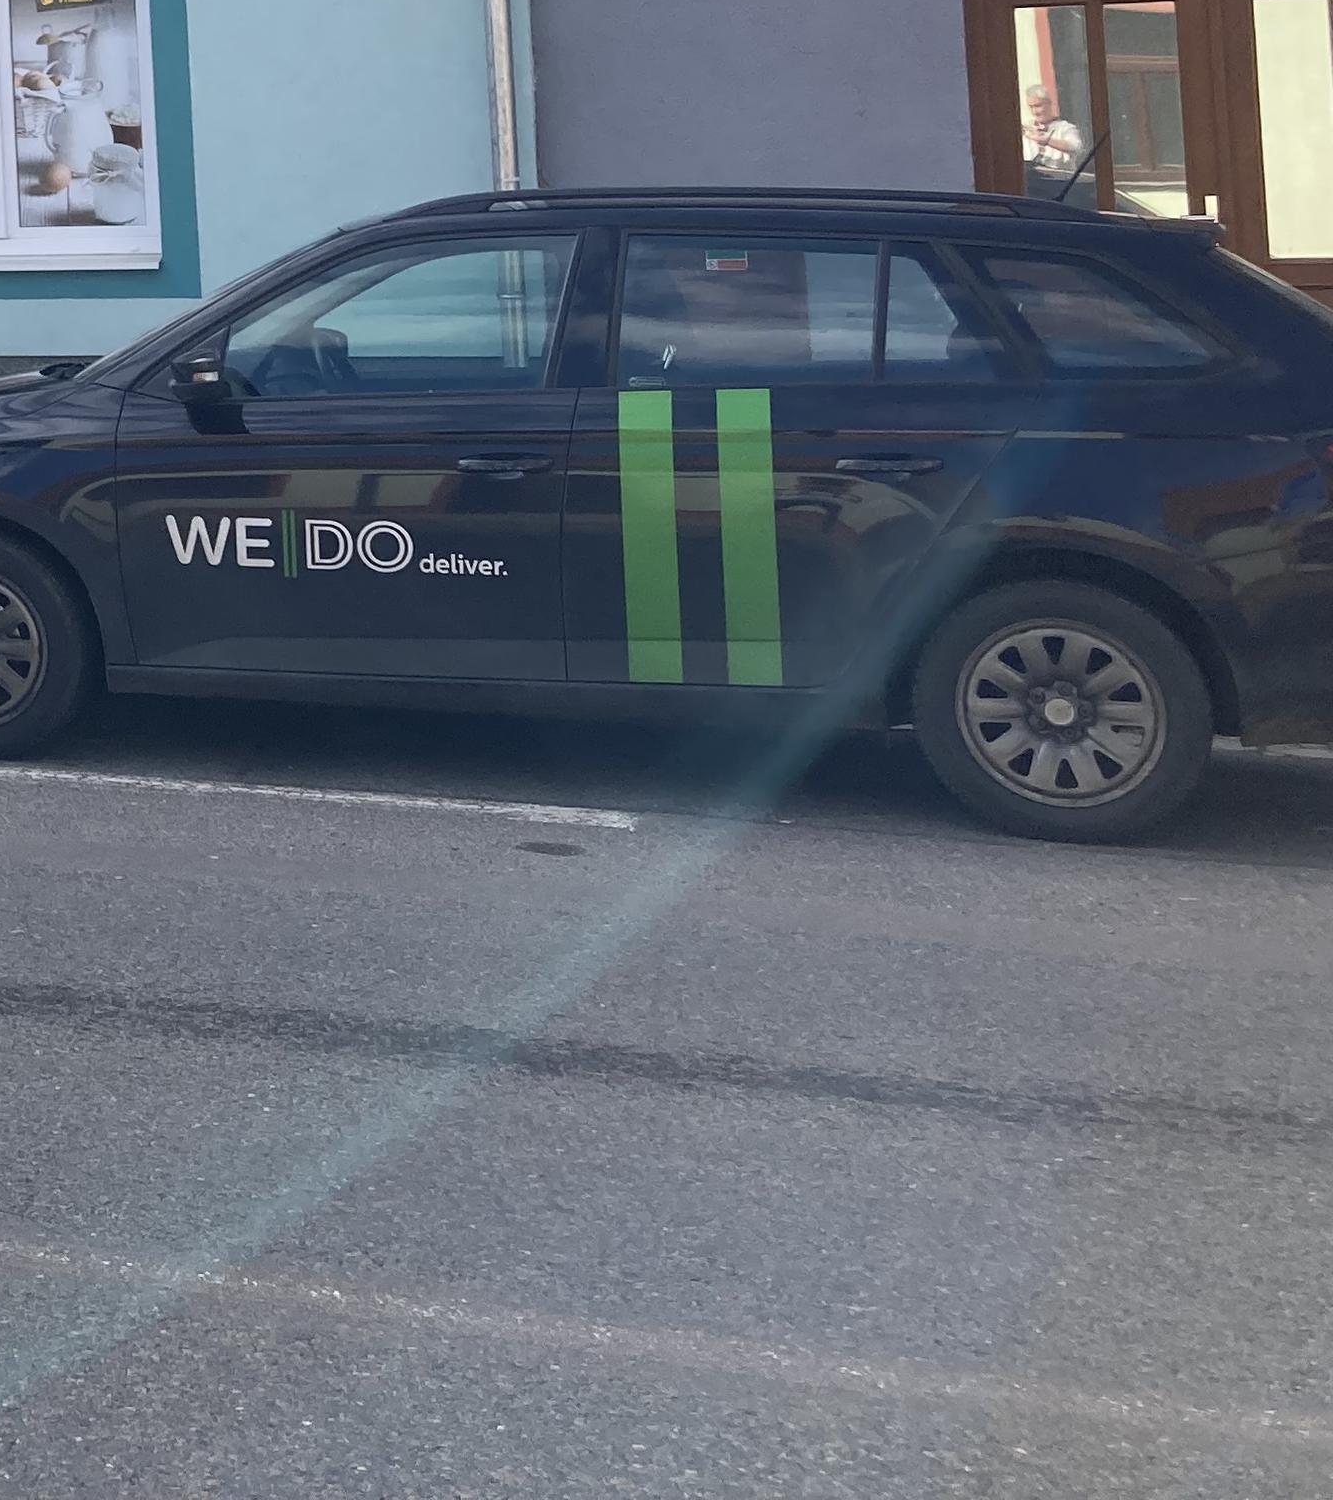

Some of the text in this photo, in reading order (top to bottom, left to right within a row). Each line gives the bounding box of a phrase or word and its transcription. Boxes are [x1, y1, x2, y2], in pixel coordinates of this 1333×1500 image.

[165, 515, 509, 576] WE DO deliver.
